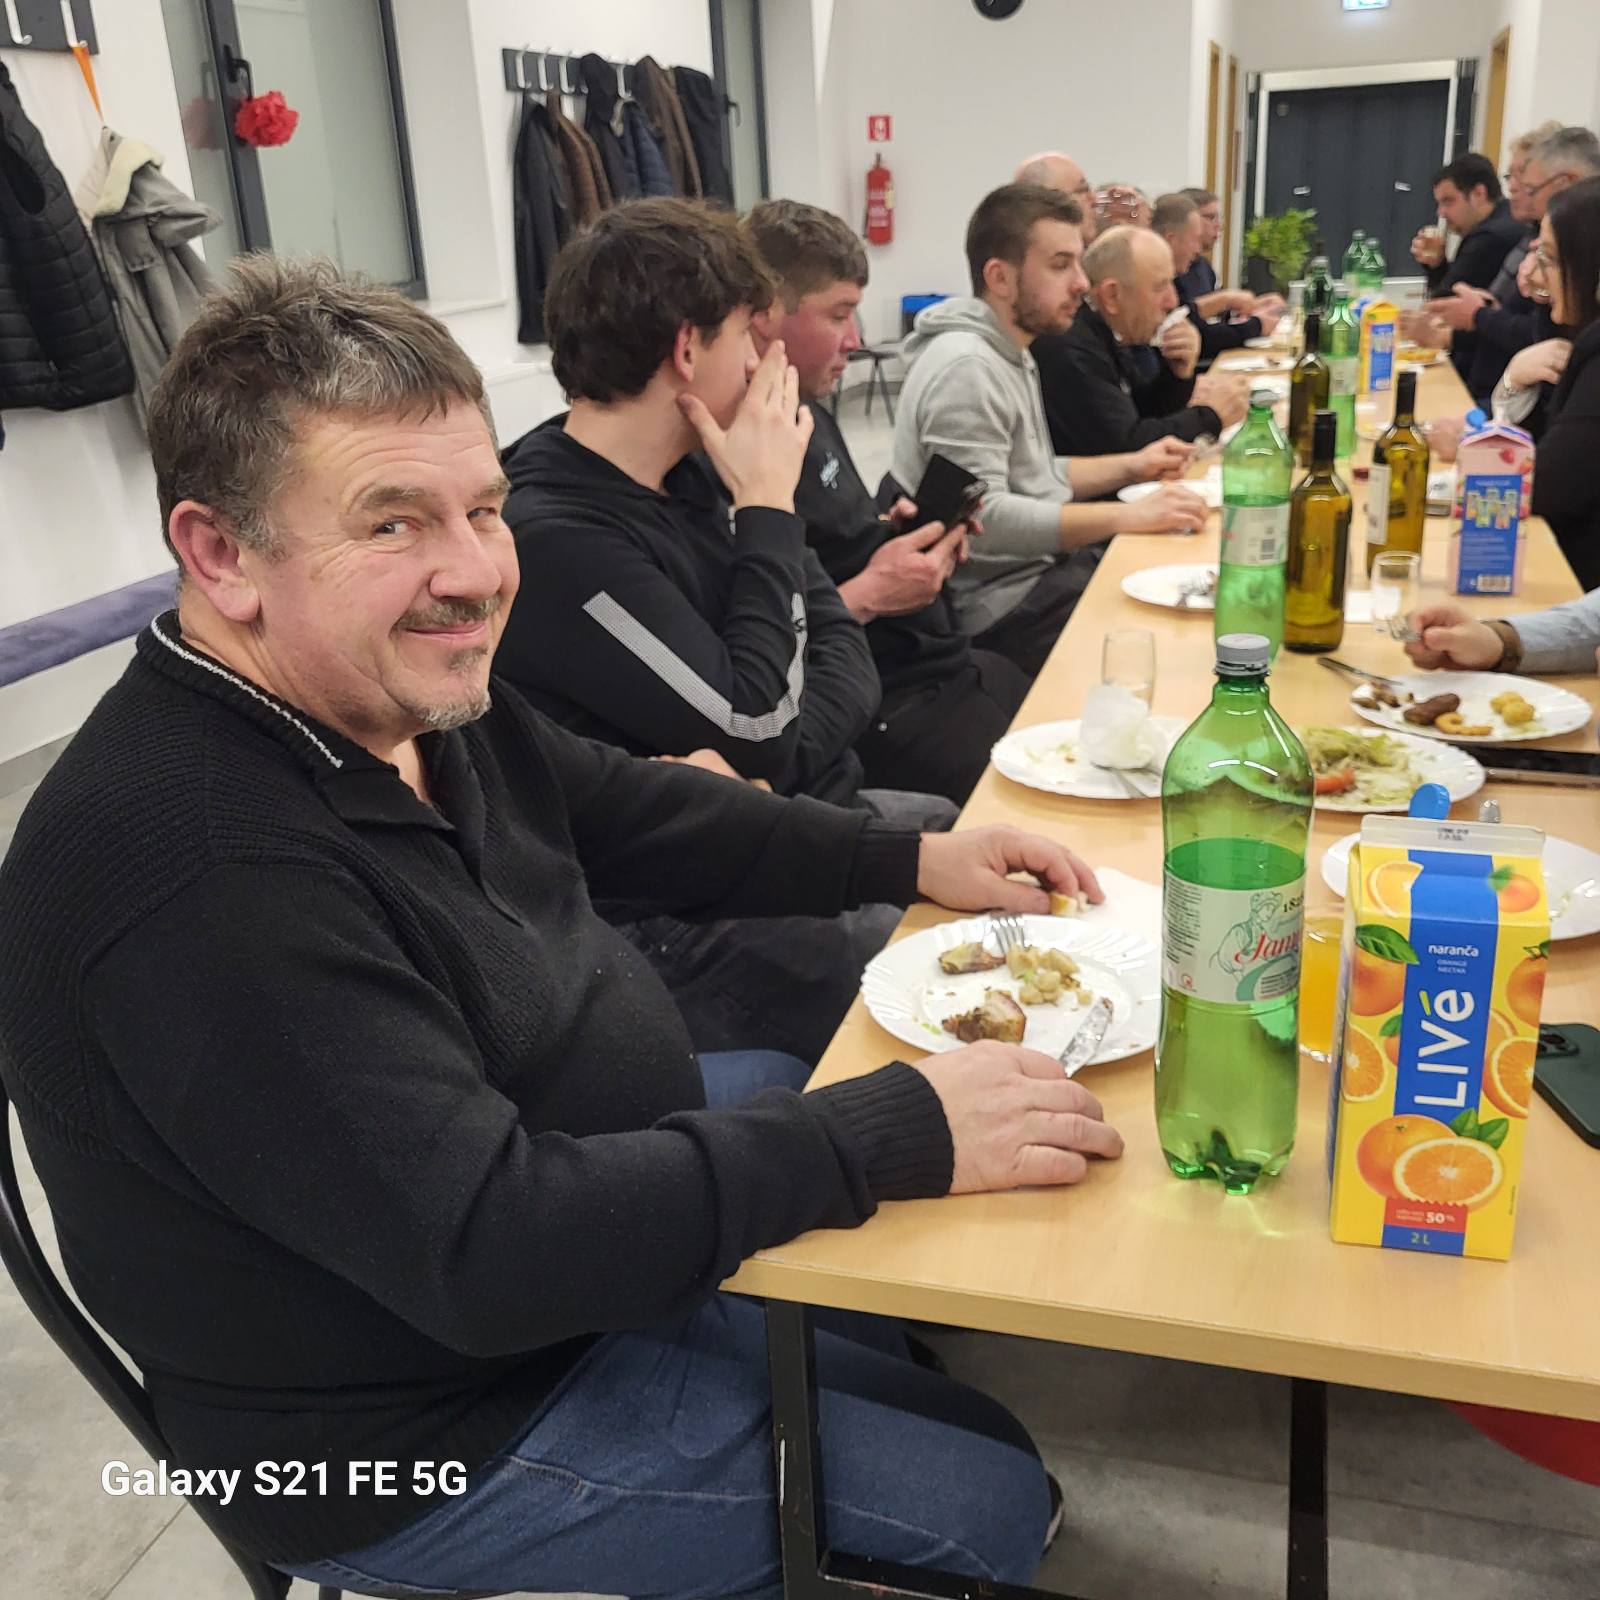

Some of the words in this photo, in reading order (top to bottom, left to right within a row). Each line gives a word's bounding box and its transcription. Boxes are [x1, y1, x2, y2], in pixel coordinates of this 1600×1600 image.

[1427, 944, 1480, 958] naranča
[1410, 1231, 1420, 1244] 2
[1422, 1233, 1431, 1246] L
